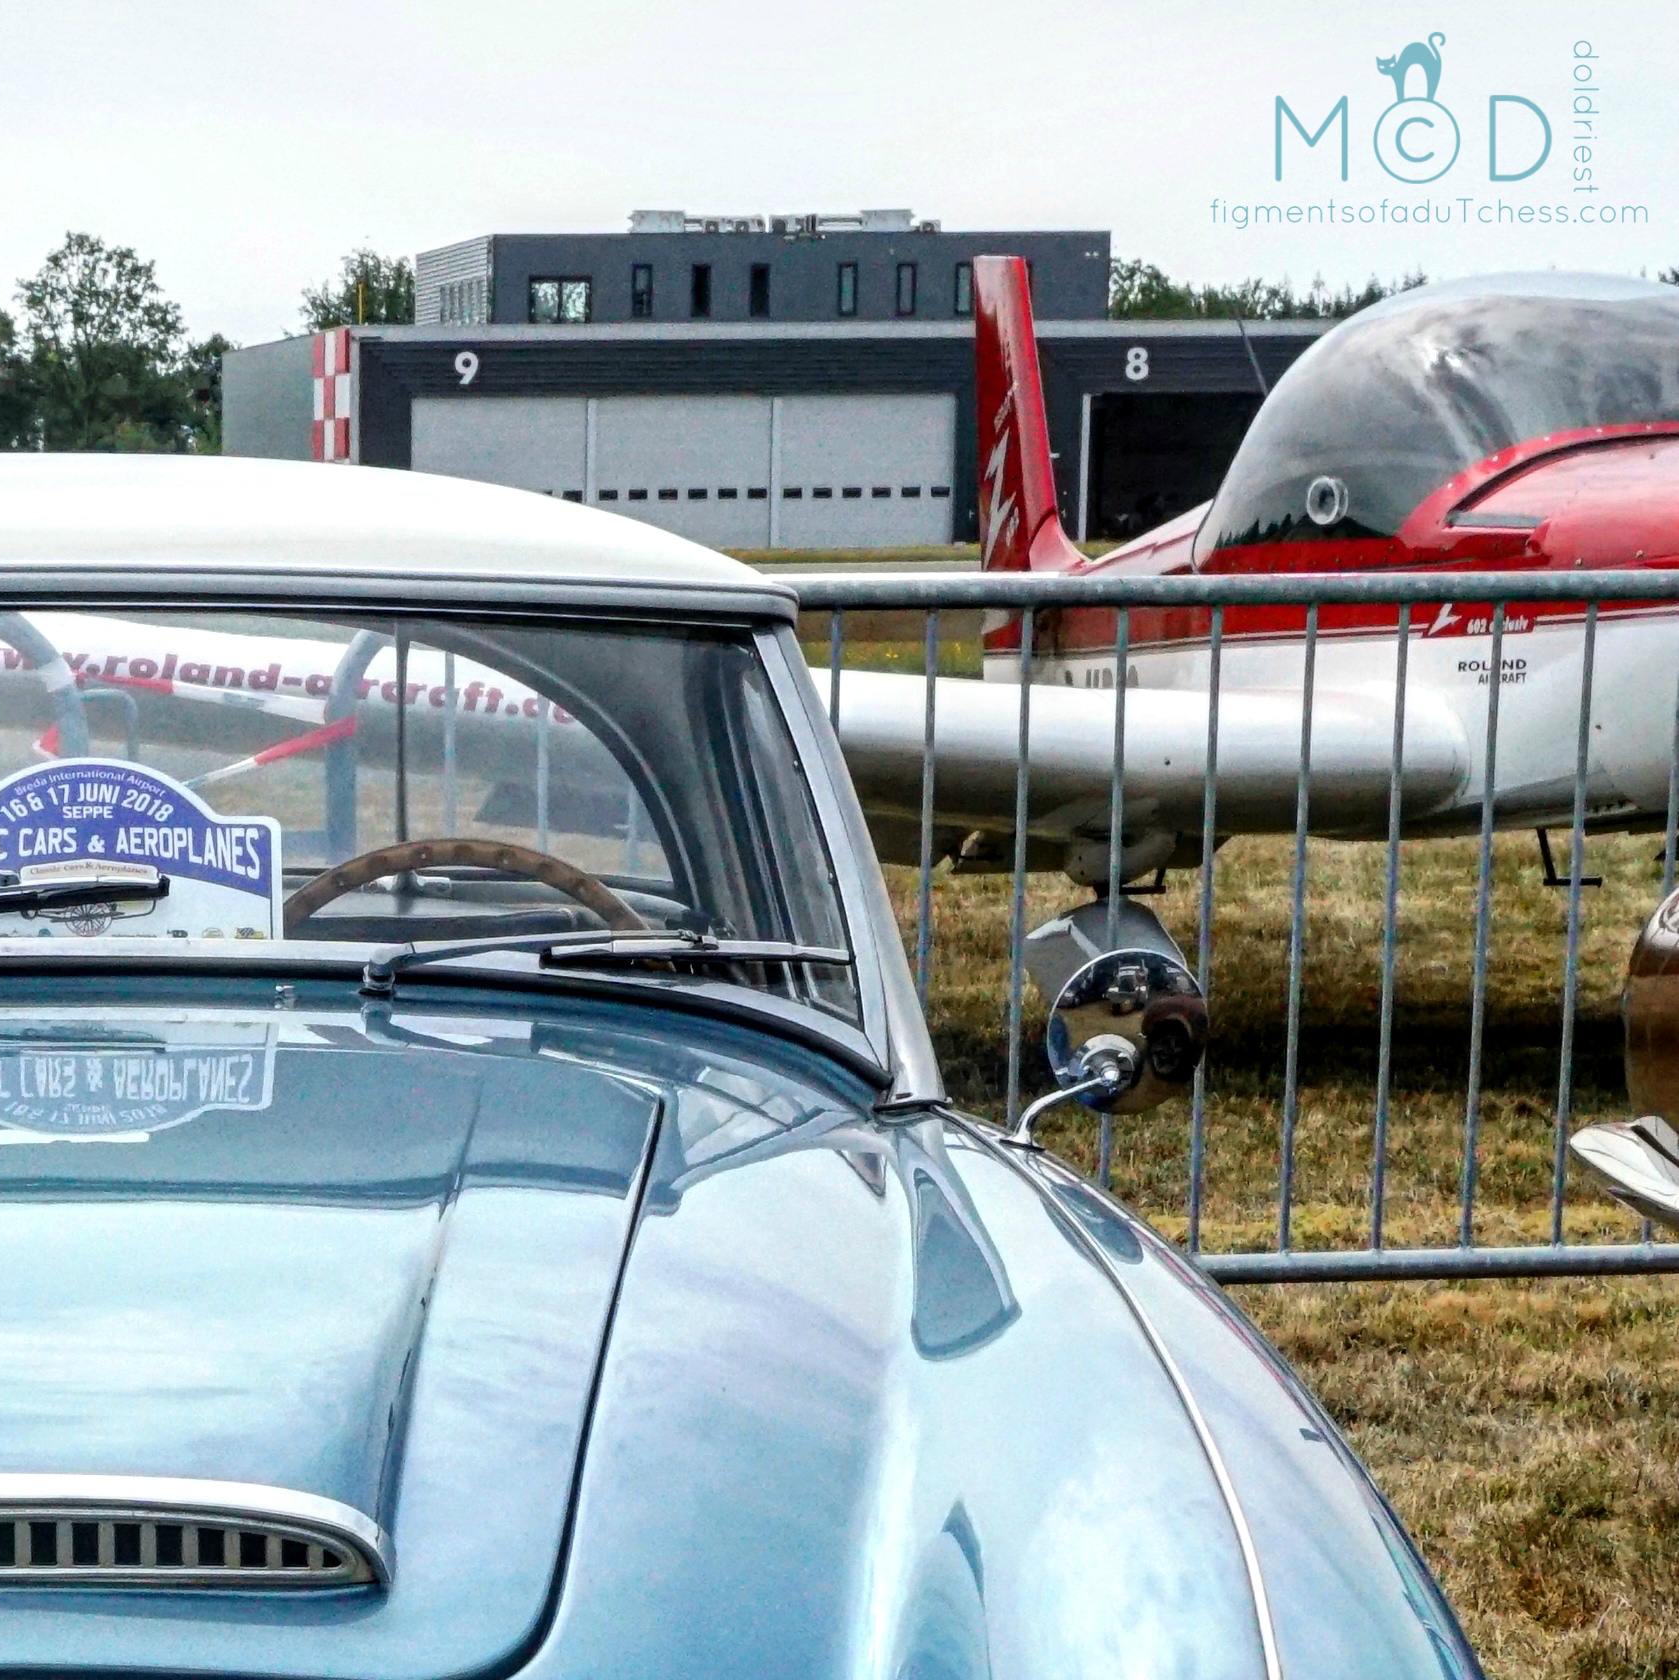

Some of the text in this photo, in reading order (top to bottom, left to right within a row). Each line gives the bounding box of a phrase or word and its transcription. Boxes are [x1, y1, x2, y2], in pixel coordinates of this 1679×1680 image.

[454, 351, 479, 385] 9
[1125, 347, 1149, 381] 8
[1457, 659, 1527, 672] ROLND
[49, 770, 124, 784] International
[127, 775, 166, 798] Airport
[0, 783, 174, 822] 16 & 17 JUNI 2018
[62, 806, 114, 819] SEPPE
[18, 827, 77, 858] CARS
[87, 834, 106, 854] &
[115, 827, 260, 880] AEROPLANES
